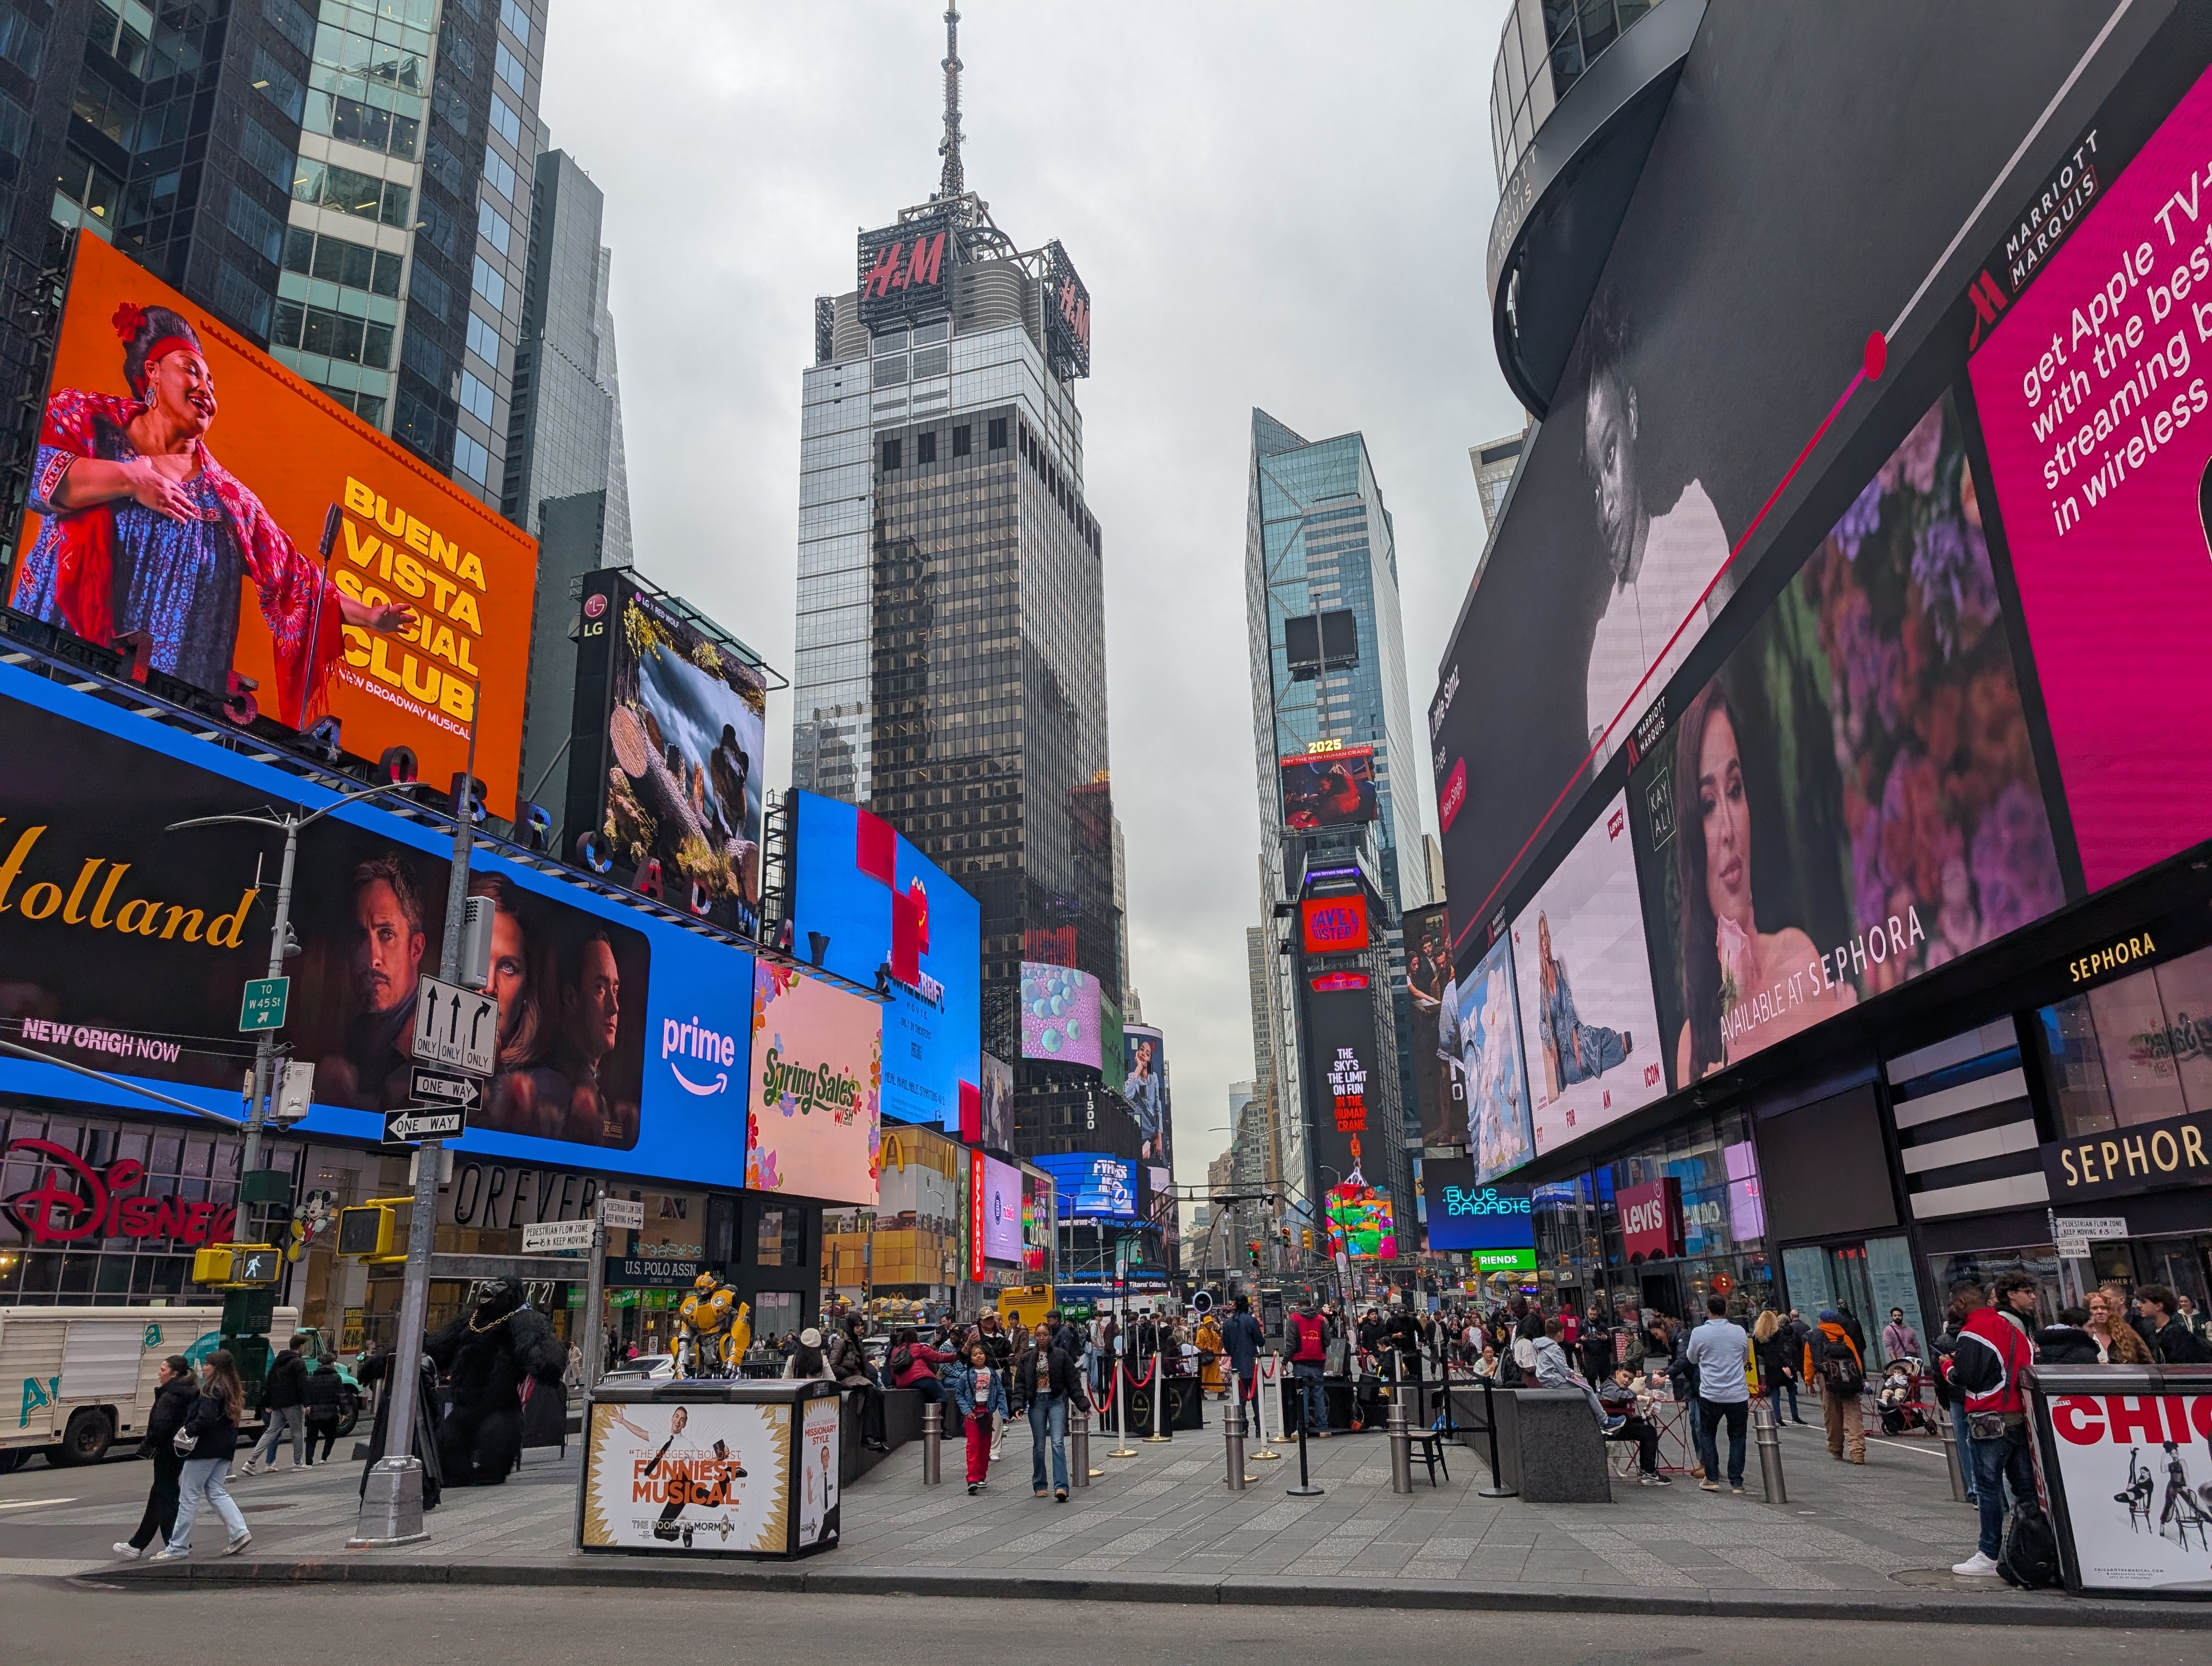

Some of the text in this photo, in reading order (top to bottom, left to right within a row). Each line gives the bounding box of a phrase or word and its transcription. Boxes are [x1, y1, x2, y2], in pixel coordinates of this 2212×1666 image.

[1490, 144, 1536, 257] MARRIOTT
[2006, 129, 2099, 260] MARRIOTT
[1494, 183, 1532, 274] MARQUIS
[2012, 173, 2094, 285] MARQUIS
[864, 232, 946, 299] H&M
[1060, 276, 1090, 353] H&M
[2022, 241, 2155, 407] get Apple
[2031, 369, 2092, 444] with
[2093, 313, 2145, 380] the
[2043, 328, 2191, 490] streaming
[2053, 379, 2209, 537] in wireless
[345, 476, 486, 592] BUENA
[342, 517, 482, 636] VISTA
[642, 597, 650, 607] LG
[654, 606, 665, 619] RED
[665, 614, 679, 629] WOLF
[584, 622, 603, 637] LG
[339, 625, 475, 723] CLUB
[366, 683, 427, 717] BROADWAY
[427, 710, 471, 741] MUSICAL
[1431, 664, 1459, 741] Little Simz
[1638, 696, 1666, 739] MARRIOTT
[1309, 739, 1342, 754] 2025
[1641, 717, 1665, 754] MARQUIS
[1435, 746, 1446, 779] Free
[1443, 776, 1463, 820] New Single
[1651, 780, 1667, 813] KAY
[1656, 808, 1670, 837] ALI
[1493, 906, 1505, 927] MARRIOTT
[1494, 919, 1505, 938] MARQUIS
[2070, 932, 2156, 982] SEPHORA
[1320, 981, 1340, 989] HUMAN
[1720, 906, 1925, 1044] AVAILABLE AT SEPHORA
[261, 984, 272, 994] TO
[249, 997, 281, 1009] W 45 St
[906, 1001, 928, 1020] MOVIE
[23, 1018, 181, 1063] NEW NOW
[901, 1017, 931, 1041] ONLY IN THEATERS
[417, 1040, 438, 1055] ONLY
[441, 1045, 460, 1061] ONLY
[662, 1016, 735, 1067] prime
[467, 1052, 488, 1068] ONLY
[1334, 1059, 1359, 1071] SKY'S
[1337, 1048, 1353, 1059] THE
[422, 1079, 473, 1099] ONE WAY
[763, 1048, 856, 1115] Spring Sales
[1327, 1071, 1367, 1084] THE LIMIT
[1333, 1083, 1364, 1095] ON FUN
[897, 1077, 919, 1095] AVAILABLE
[919, 1086, 937, 1103] STARTING
[937, 1092, 946, 1106] 4/1
[1336, 1095, 1362, 1107] IN THE
[1566, 1108, 1576, 1129] FOR
[1603, 1090, 1611, 1110] AN
[1644, 1063, 1660, 1088] ICON
[396, 1116, 455, 1133] ONE WAY
[1334, 1107, 1367, 1119] HUMAN
[438, 1163, 596, 1228] OREVER
[1447, 1188, 1497, 1202] BLUE
[606, 1203, 642, 1215] PEDESTRIAN FLOW ZONE
[606, 1214, 626, 1224] KEEP MOVING
[526, 1224, 588, 1237] PEDESTRIAN FLOW ZONE
[552, 1236, 588, 1246] KEEP MOVING
[1030, 1226, 1038, 1245] OLD
[1039, 1225, 1051, 1248] NAVY
[626, 1261, 698, 1276] U.S. POLO ASSN.
[1479, 1255, 1517, 1264] RIENDS
[538, 1281, 556, 1304] 21
[805, 1424, 837, 1438] MISSIONARY
[813, 1434, 829, 1445] STYLE
[655, 1450, 741, 1461] BIGGEST, BOLDEST,
[633, 1459, 742, 1482] FUNNIEST
[632, 1520, 735, 1532] THE BOOK OF MORMON
